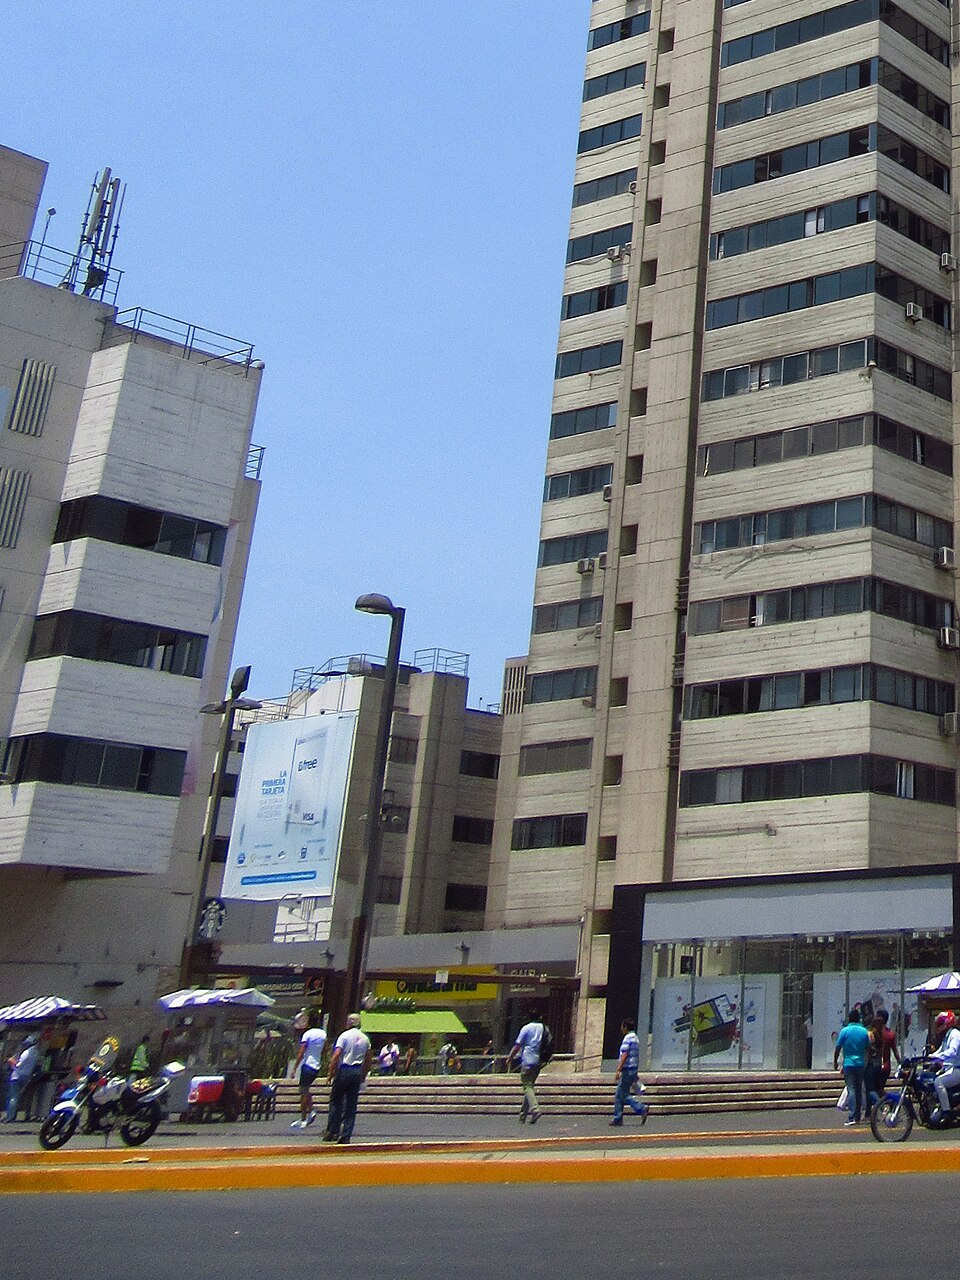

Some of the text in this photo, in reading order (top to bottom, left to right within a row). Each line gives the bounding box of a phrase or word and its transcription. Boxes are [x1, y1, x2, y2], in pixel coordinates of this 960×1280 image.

[280, 770, 287, 778] LA
[262, 779, 286, 788] PRIMERA
[262, 787, 285, 796] TARJETA
